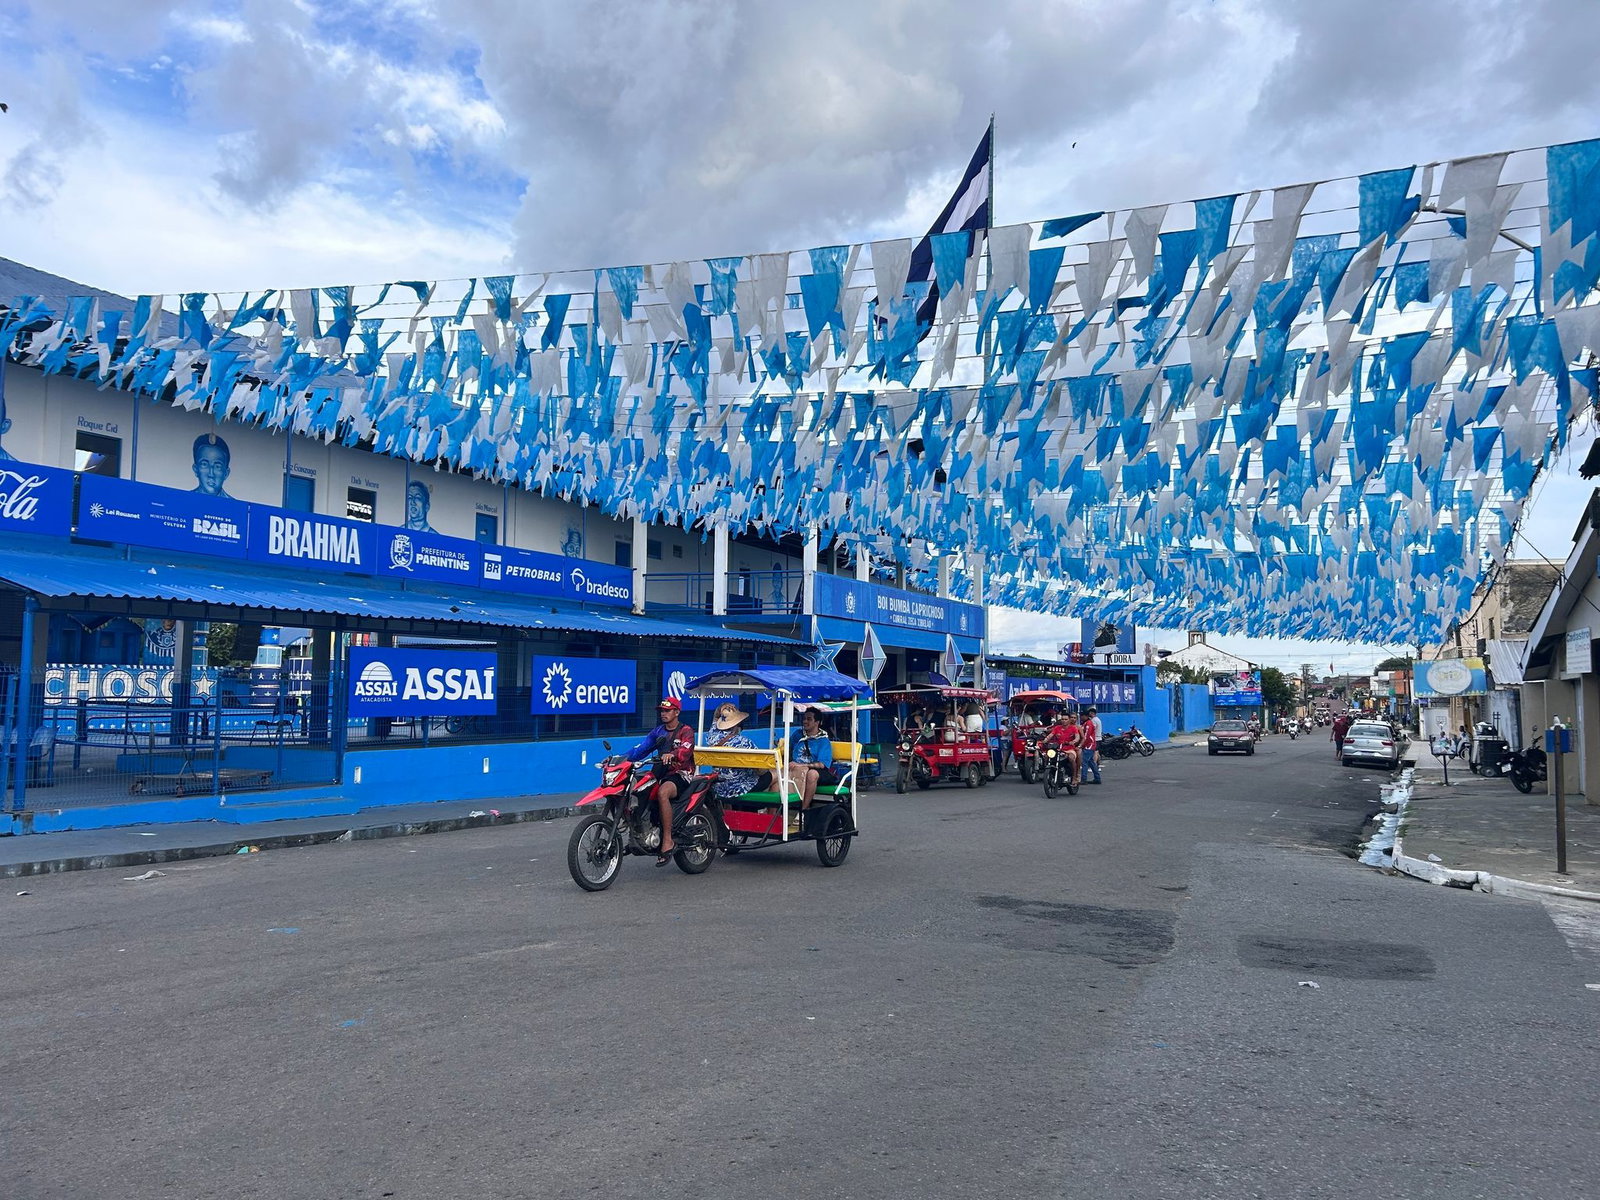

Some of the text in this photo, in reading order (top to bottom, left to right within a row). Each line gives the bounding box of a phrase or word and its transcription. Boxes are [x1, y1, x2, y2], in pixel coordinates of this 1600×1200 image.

[77, 416, 103, 431] Roque
[116, 510, 140, 519] Rouanet
[150, 513, 178, 522] MINISTÉRIO
[163, 521, 186, 529] CULTURA
[193, 518, 240, 539] BRASIL
[268, 515, 360, 565] BRAHMA
[421, 546, 465, 560] PREFEITURA DE
[415, 554, 470, 571] PARINTINS
[486, 563, 500, 574] BR
[505, 565, 562, 582] PETROBRAS
[586, 578, 629, 599] bradesco
[878, 596, 888, 610] BOI
[911, 602, 944, 620] CAPRICHOSO
[1114, 654, 1132, 663] DORA
[354, 681, 397, 696] ASSAÍ
[402, 666, 494, 700] ASSAÍ
[576, 684, 629, 704] eneva
